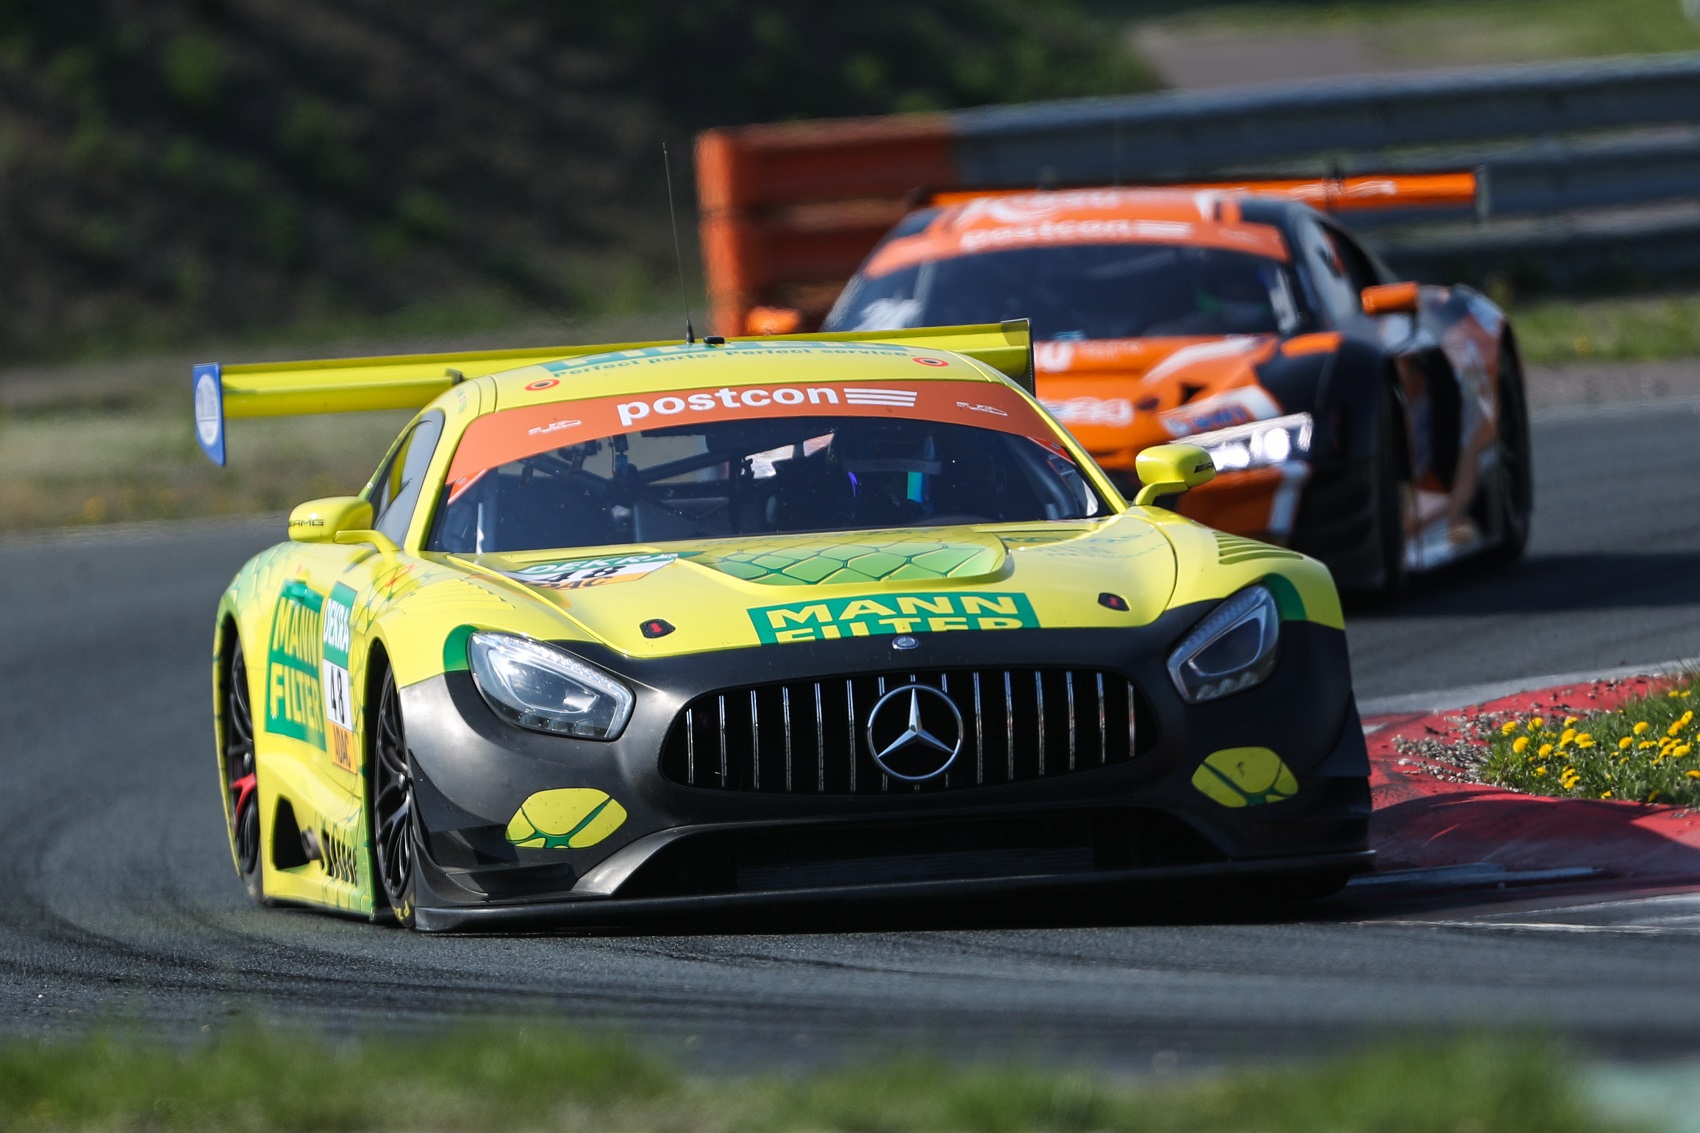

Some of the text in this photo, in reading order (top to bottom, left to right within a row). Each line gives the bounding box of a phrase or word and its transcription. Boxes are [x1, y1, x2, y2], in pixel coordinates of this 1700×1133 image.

[553, 359, 641, 377] Perfect
[726, 348, 813, 356] Perfect
[616, 387, 839, 427] postcon
[293, 519, 324, 527] AMG
[272, 596, 320, 669] MANN
[323, 598, 350, 653] DEKRA
[765, 596, 1019, 629] MANN
[270, 662, 324, 733] FILTER
[330, 665, 345, 724] 48
